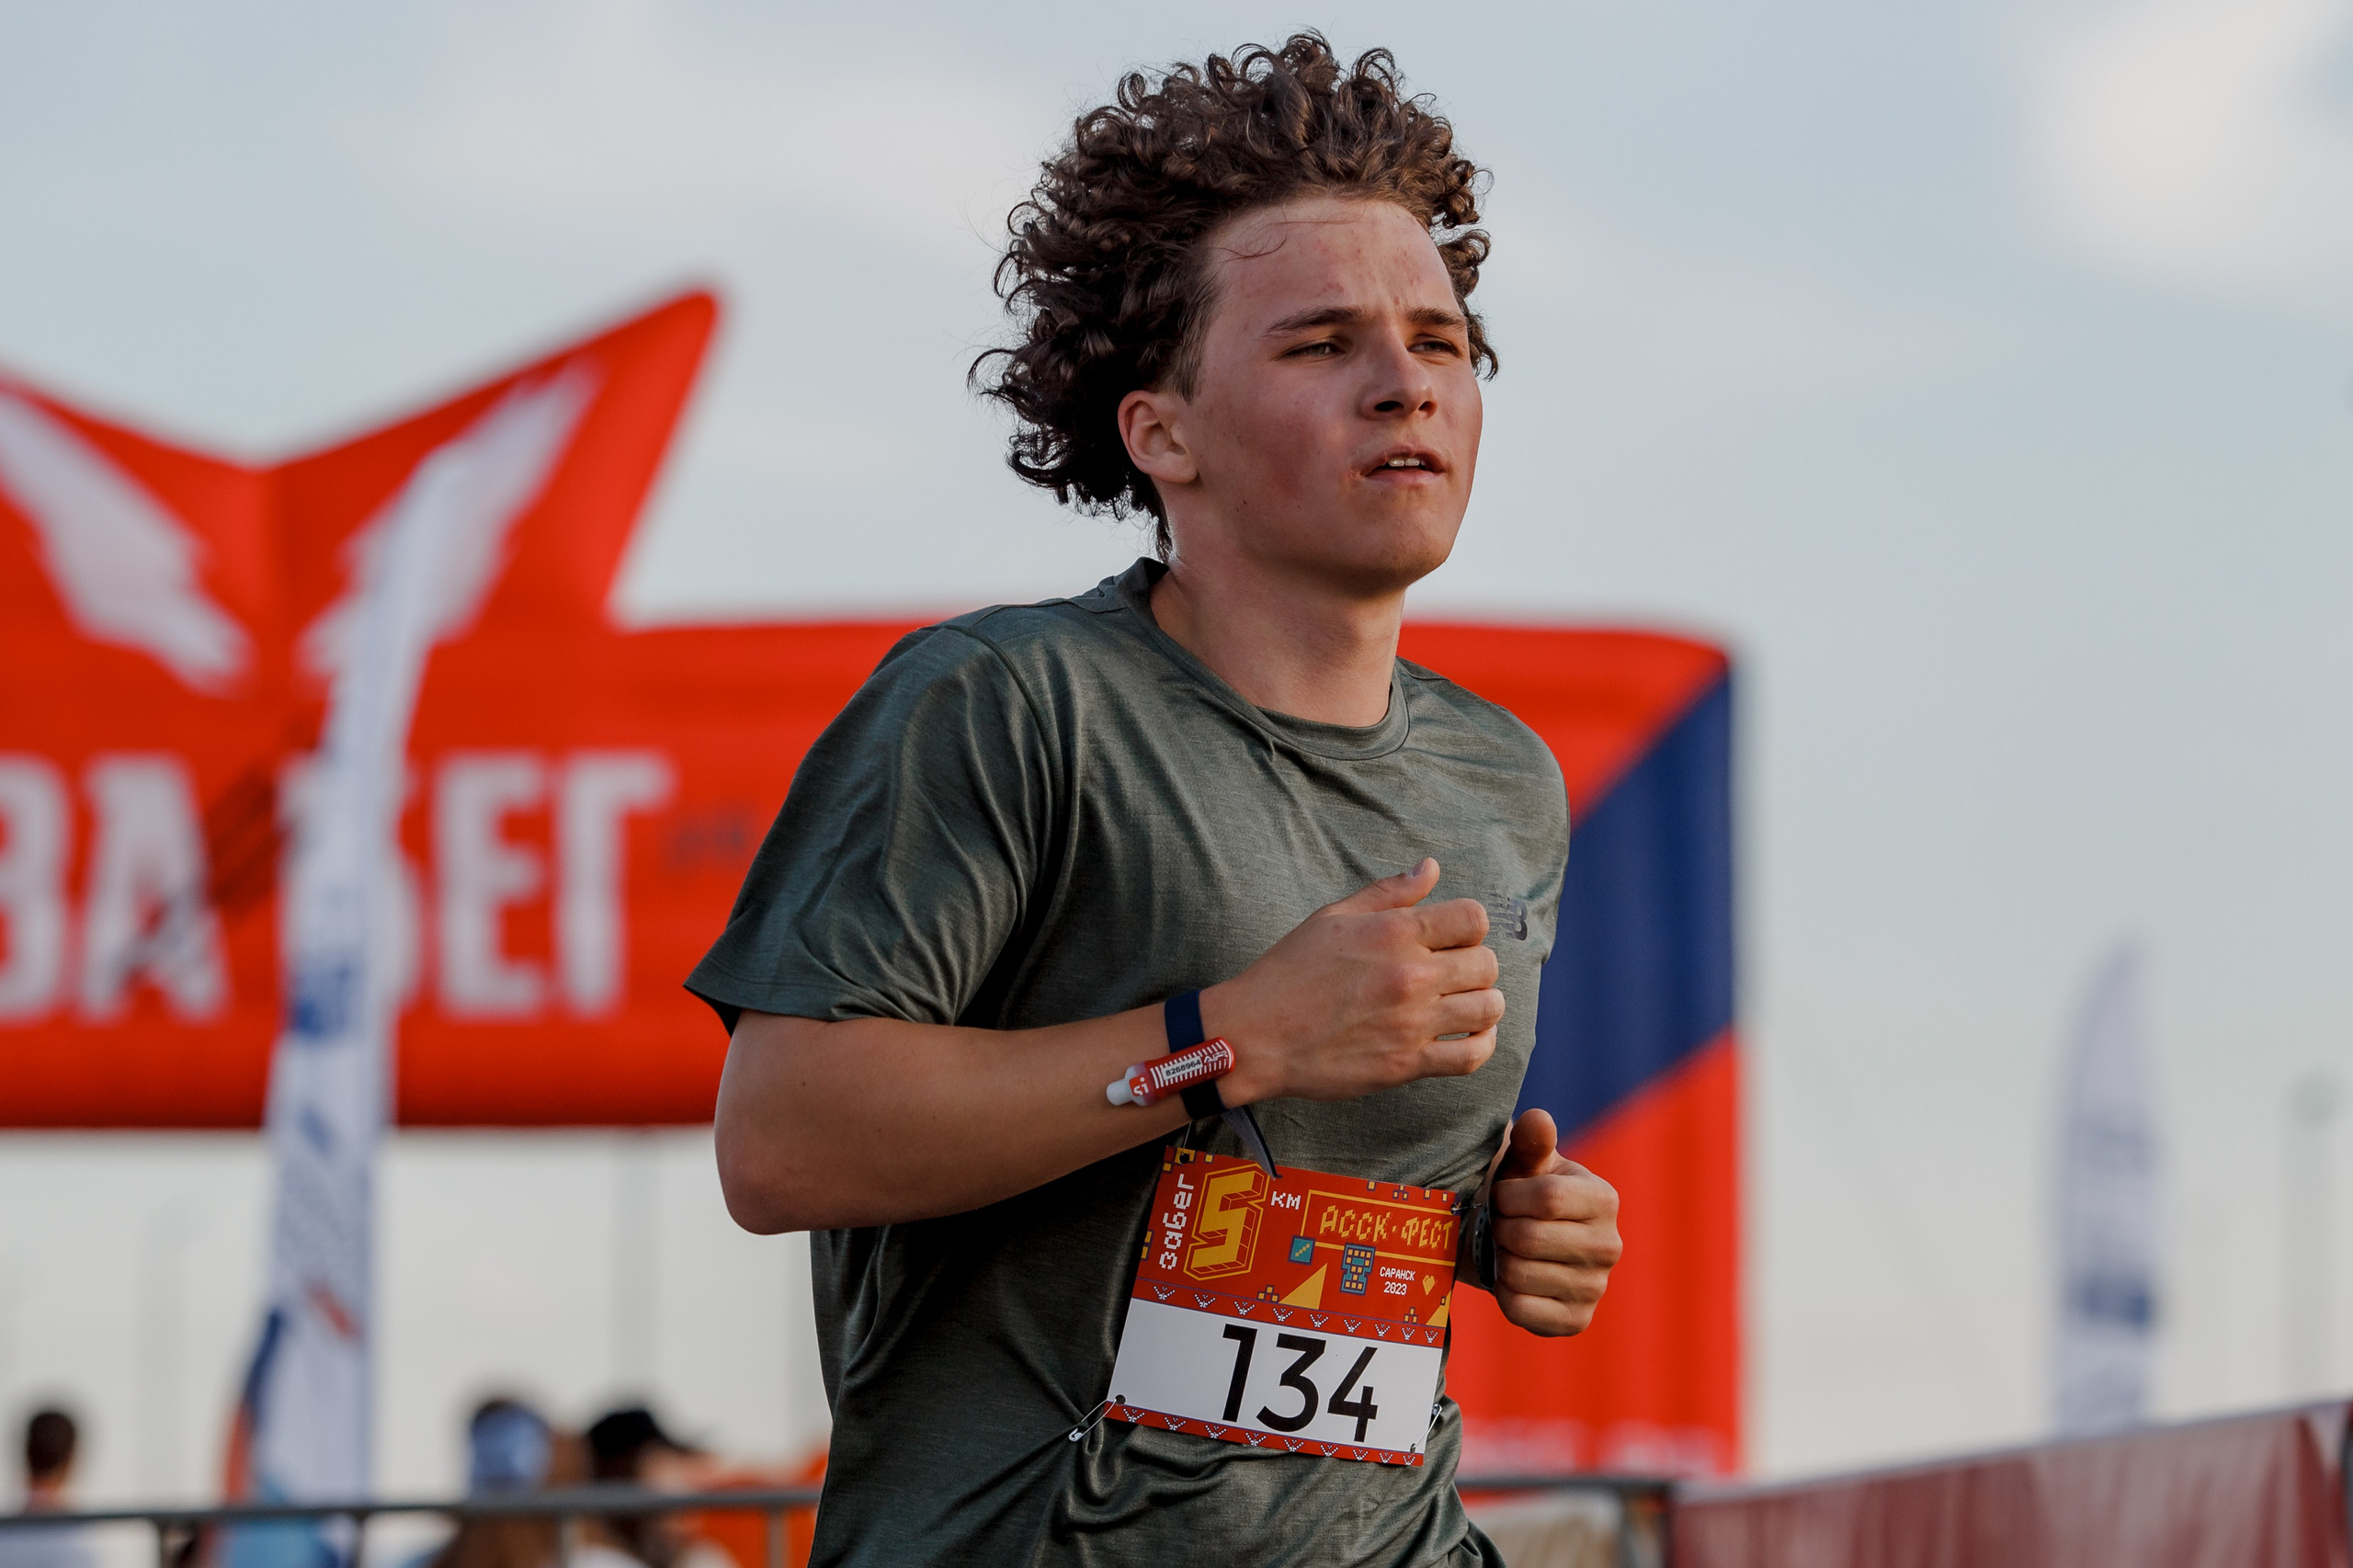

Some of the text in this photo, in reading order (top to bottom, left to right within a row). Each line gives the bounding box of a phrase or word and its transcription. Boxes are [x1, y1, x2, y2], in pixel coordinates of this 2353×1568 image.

[1189, 1167, 1267, 1277] 5
[1379, 1266, 1415, 1281] САРАНСК
[1383, 1281, 1407, 1296] 2023
[1222, 1323, 1379, 1443] 134
